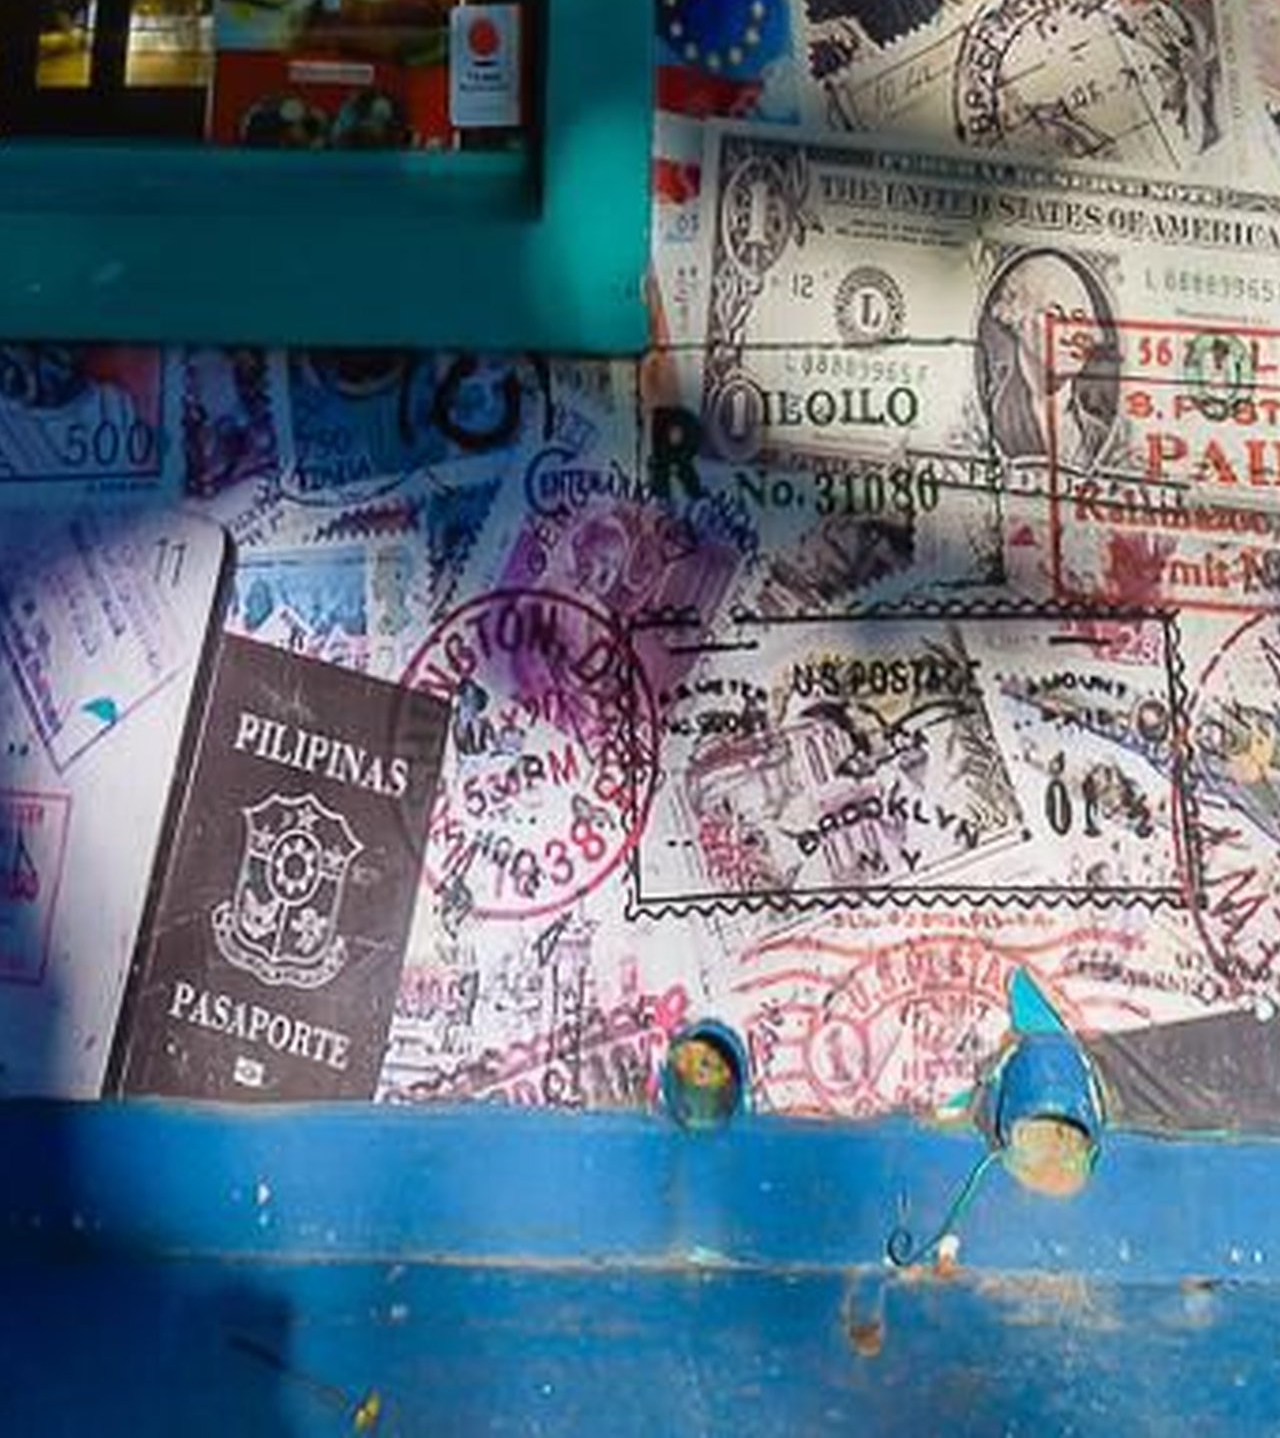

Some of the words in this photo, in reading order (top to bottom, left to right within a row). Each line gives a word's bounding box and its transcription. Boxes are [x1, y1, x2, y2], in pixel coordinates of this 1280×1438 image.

[821, 175, 880, 206] THE
[998, 192, 1104, 234] STATES
[1107, 206, 1145, 239] OF
[61, 423, 158, 468] 500
[735, 471, 805, 508] No.
[233, 712, 409, 798] PILIPINAS
[167, 981, 351, 1072] PASAPORTE
